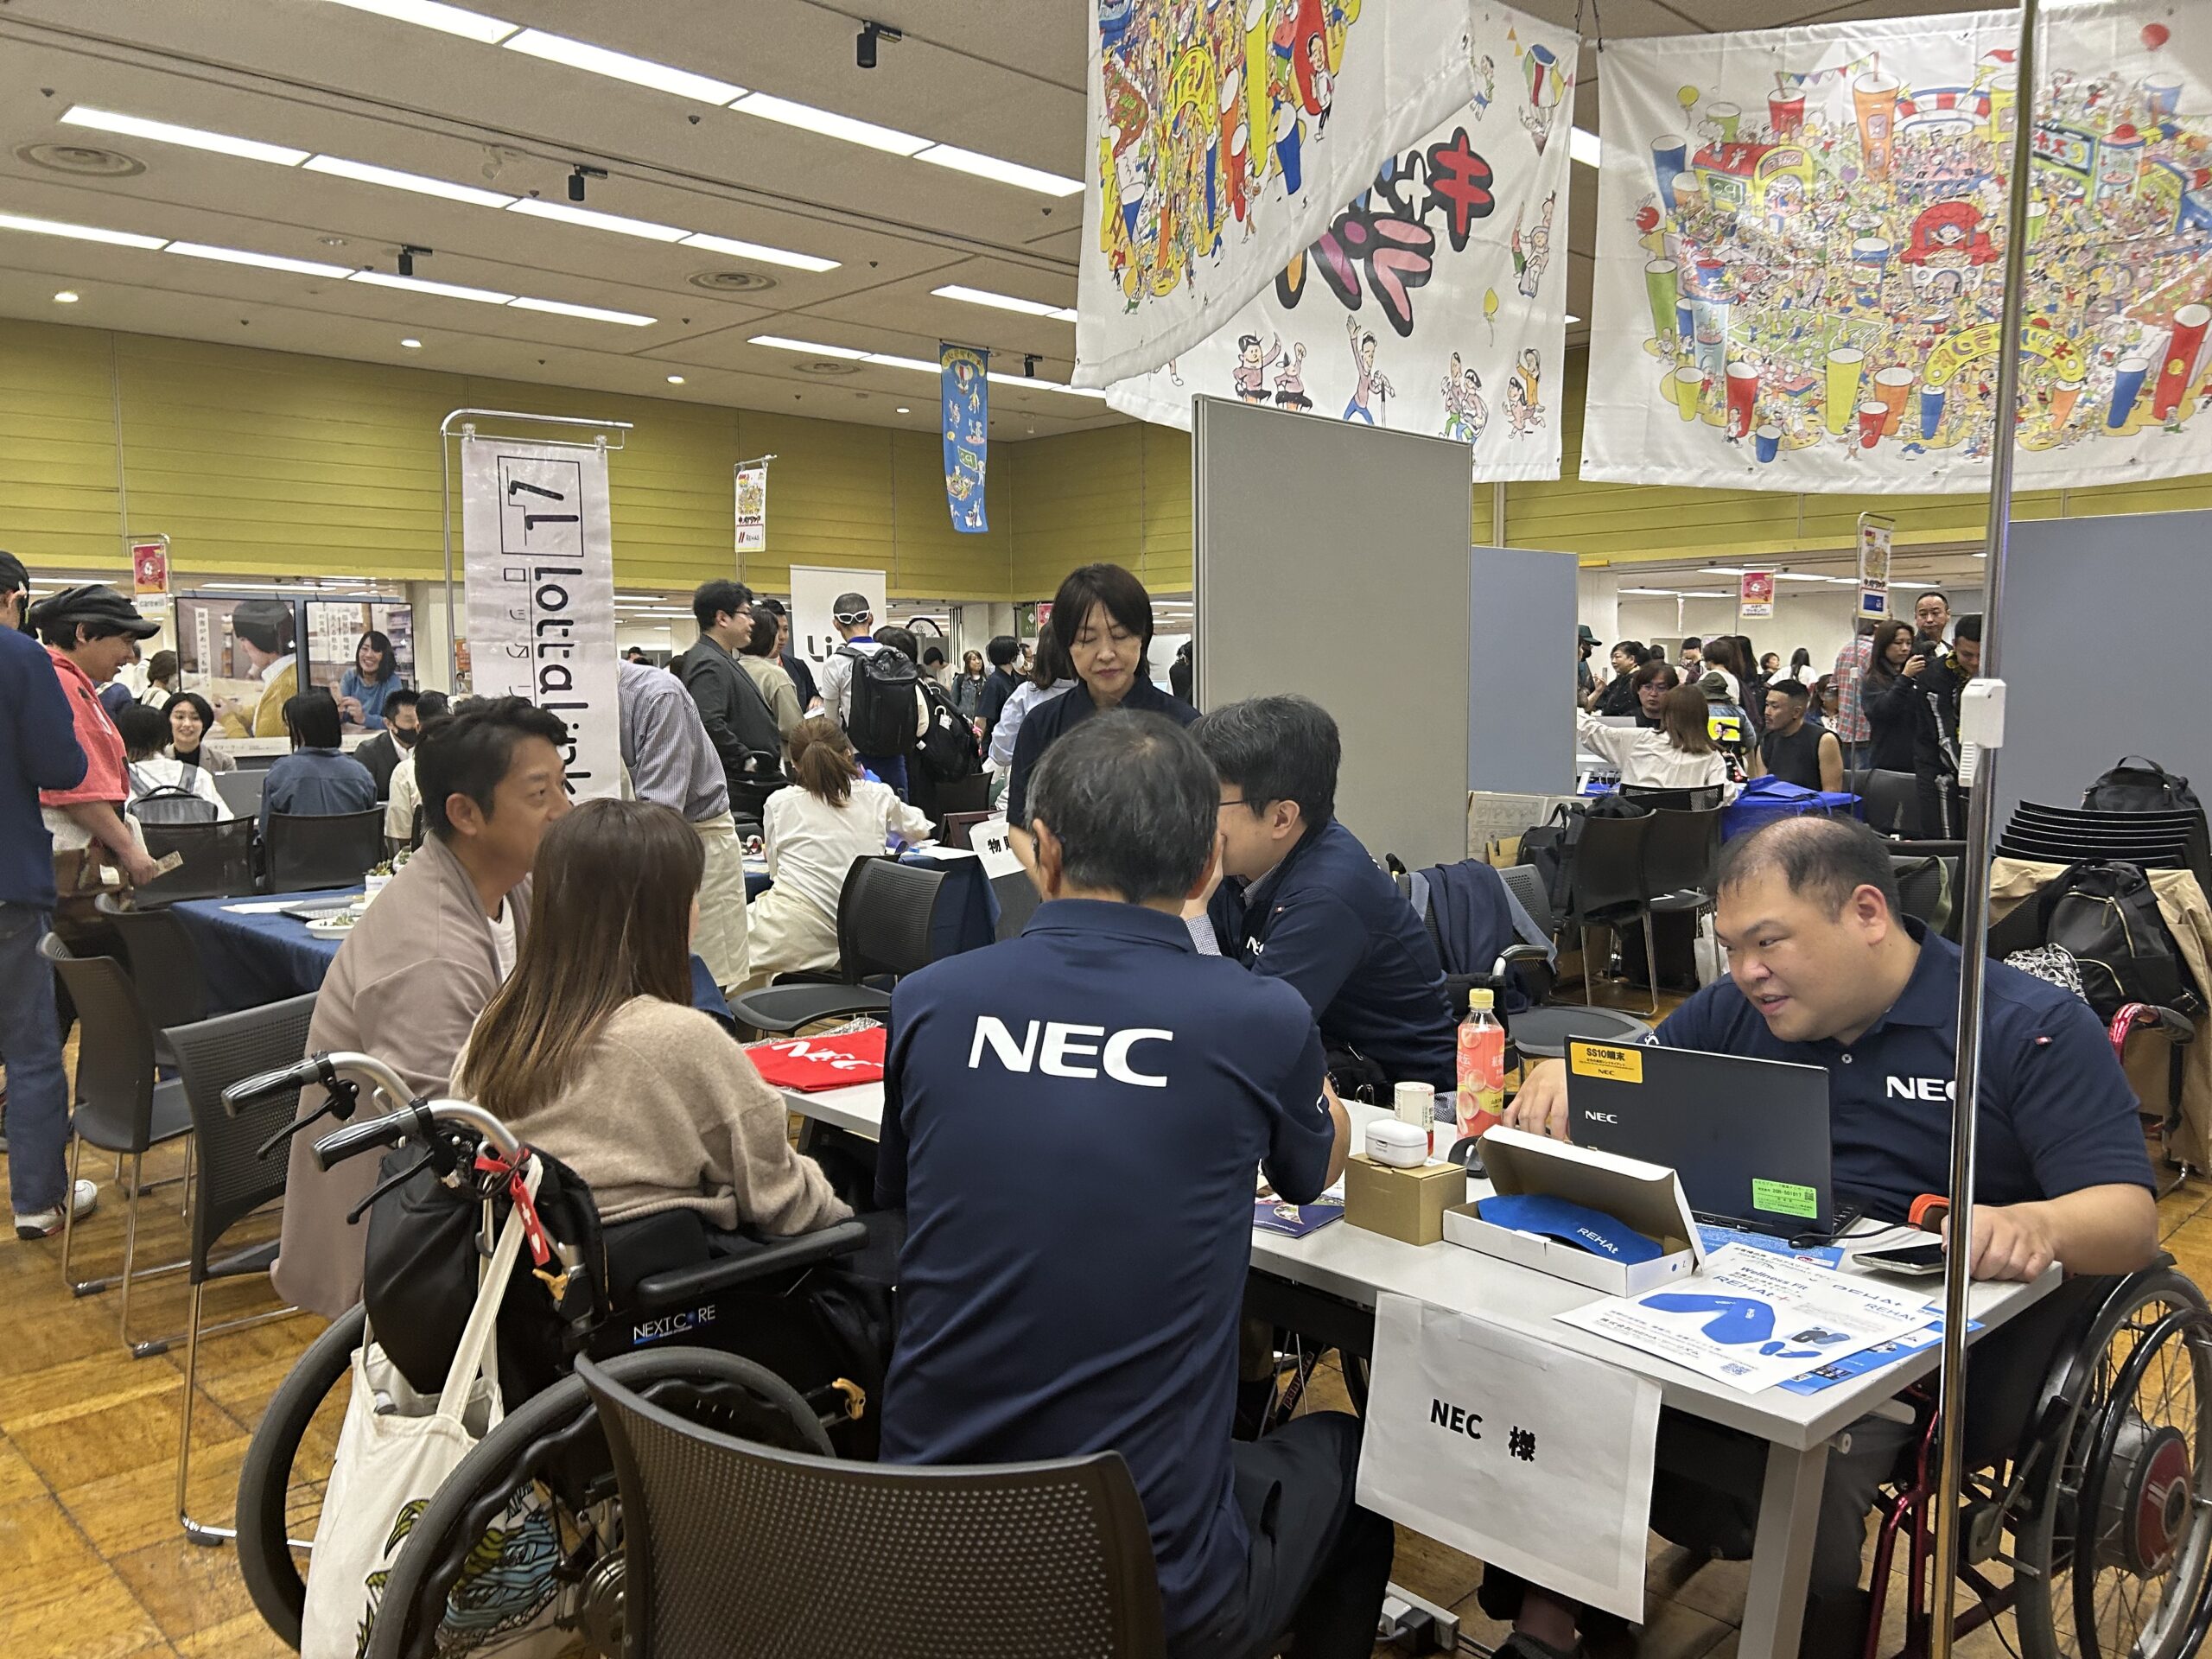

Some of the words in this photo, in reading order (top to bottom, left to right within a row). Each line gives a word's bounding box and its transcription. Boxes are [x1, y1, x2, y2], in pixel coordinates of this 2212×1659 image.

[968, 1015, 1173, 1088] NEC
[1585, 1109, 1618, 1124] NEC
[1577, 1227, 1618, 1254] REHAt
[1740, 1266, 1790, 1285] Wellness
[1430, 1398, 1483, 1440] NEC
[1509, 1426, 1535, 1462] 様
